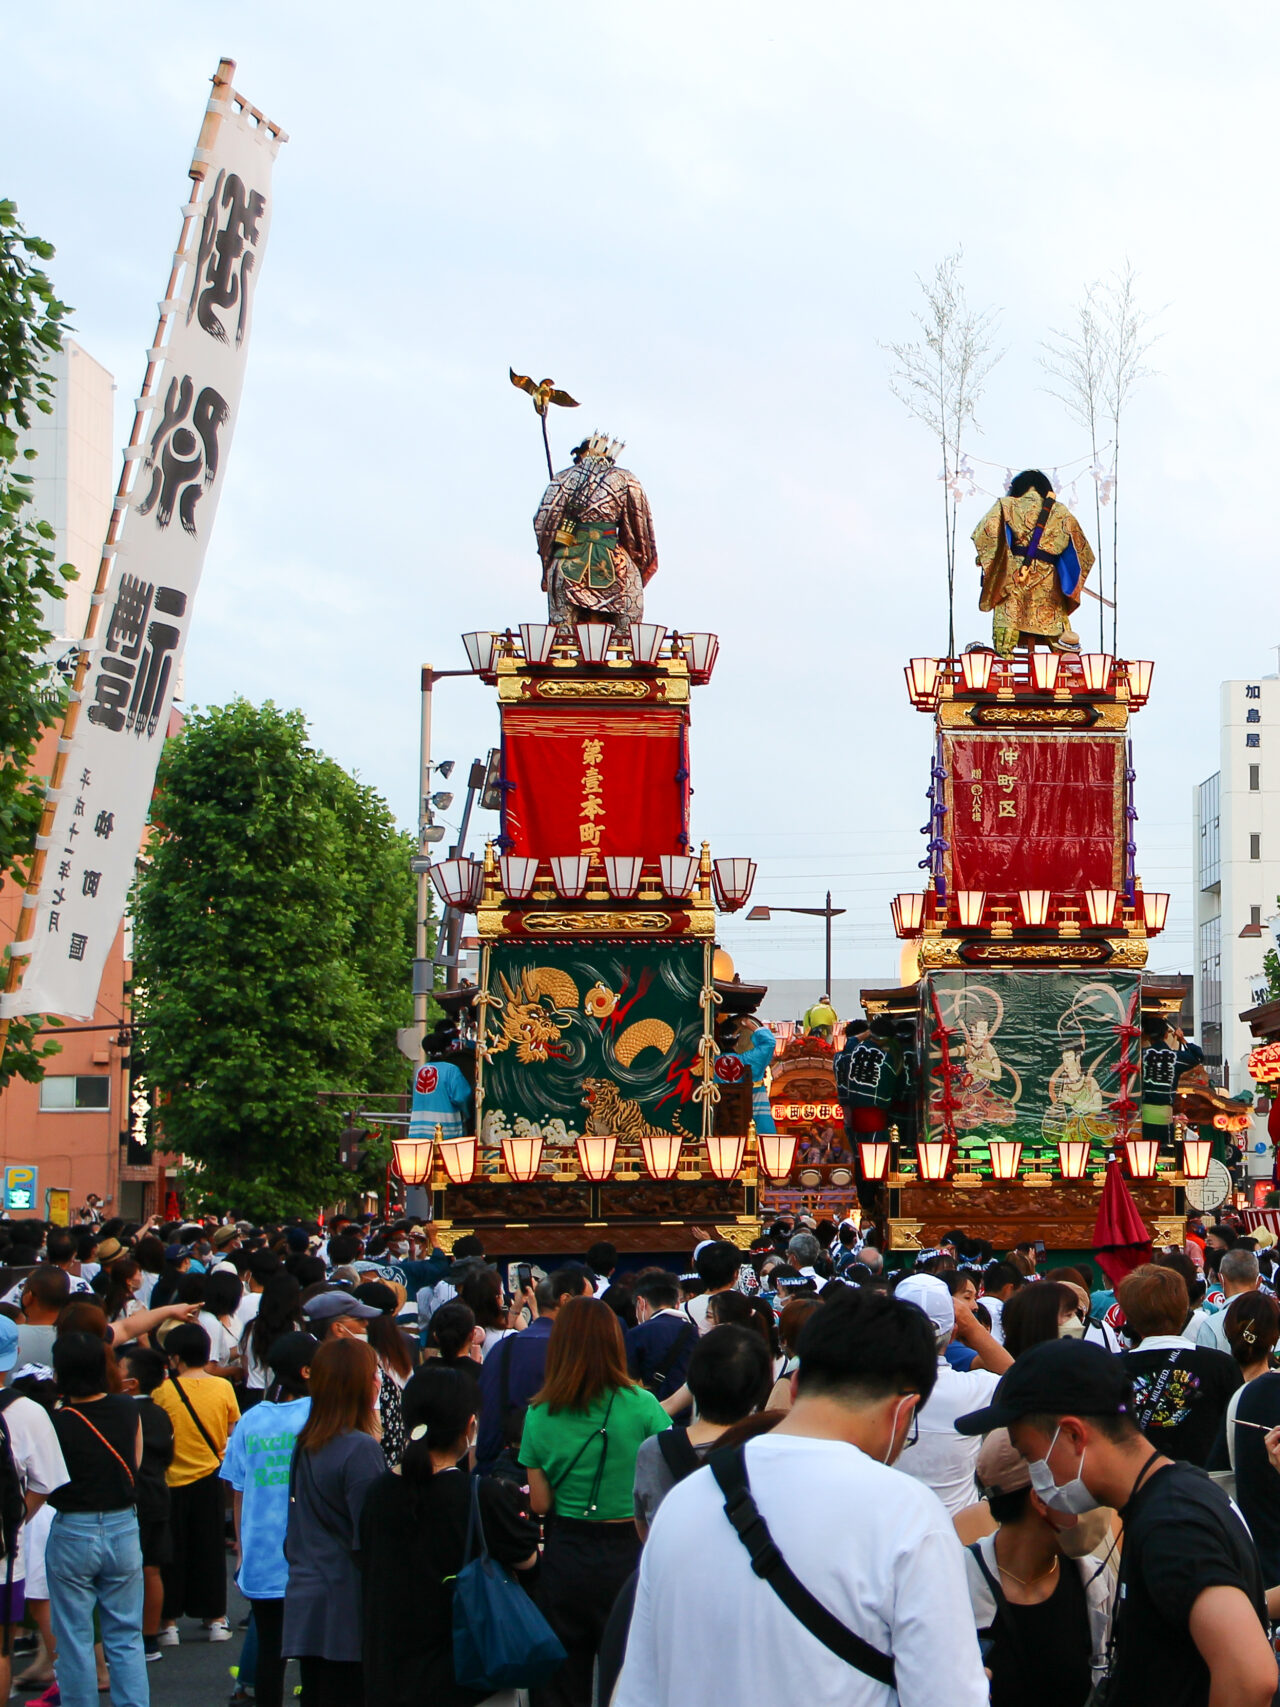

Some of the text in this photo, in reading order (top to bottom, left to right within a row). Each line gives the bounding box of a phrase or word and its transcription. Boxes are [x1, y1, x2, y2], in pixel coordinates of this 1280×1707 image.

[1245, 684, 1261, 748] 加島屋
[997, 748, 1019, 818] 仲町区
[8, 1168, 34, 1189] P
[1149, 1369, 1171, 1403] MILKFED.
[246, 1431, 298, 1455] Excit
[254, 1468, 289, 1488] Rea
